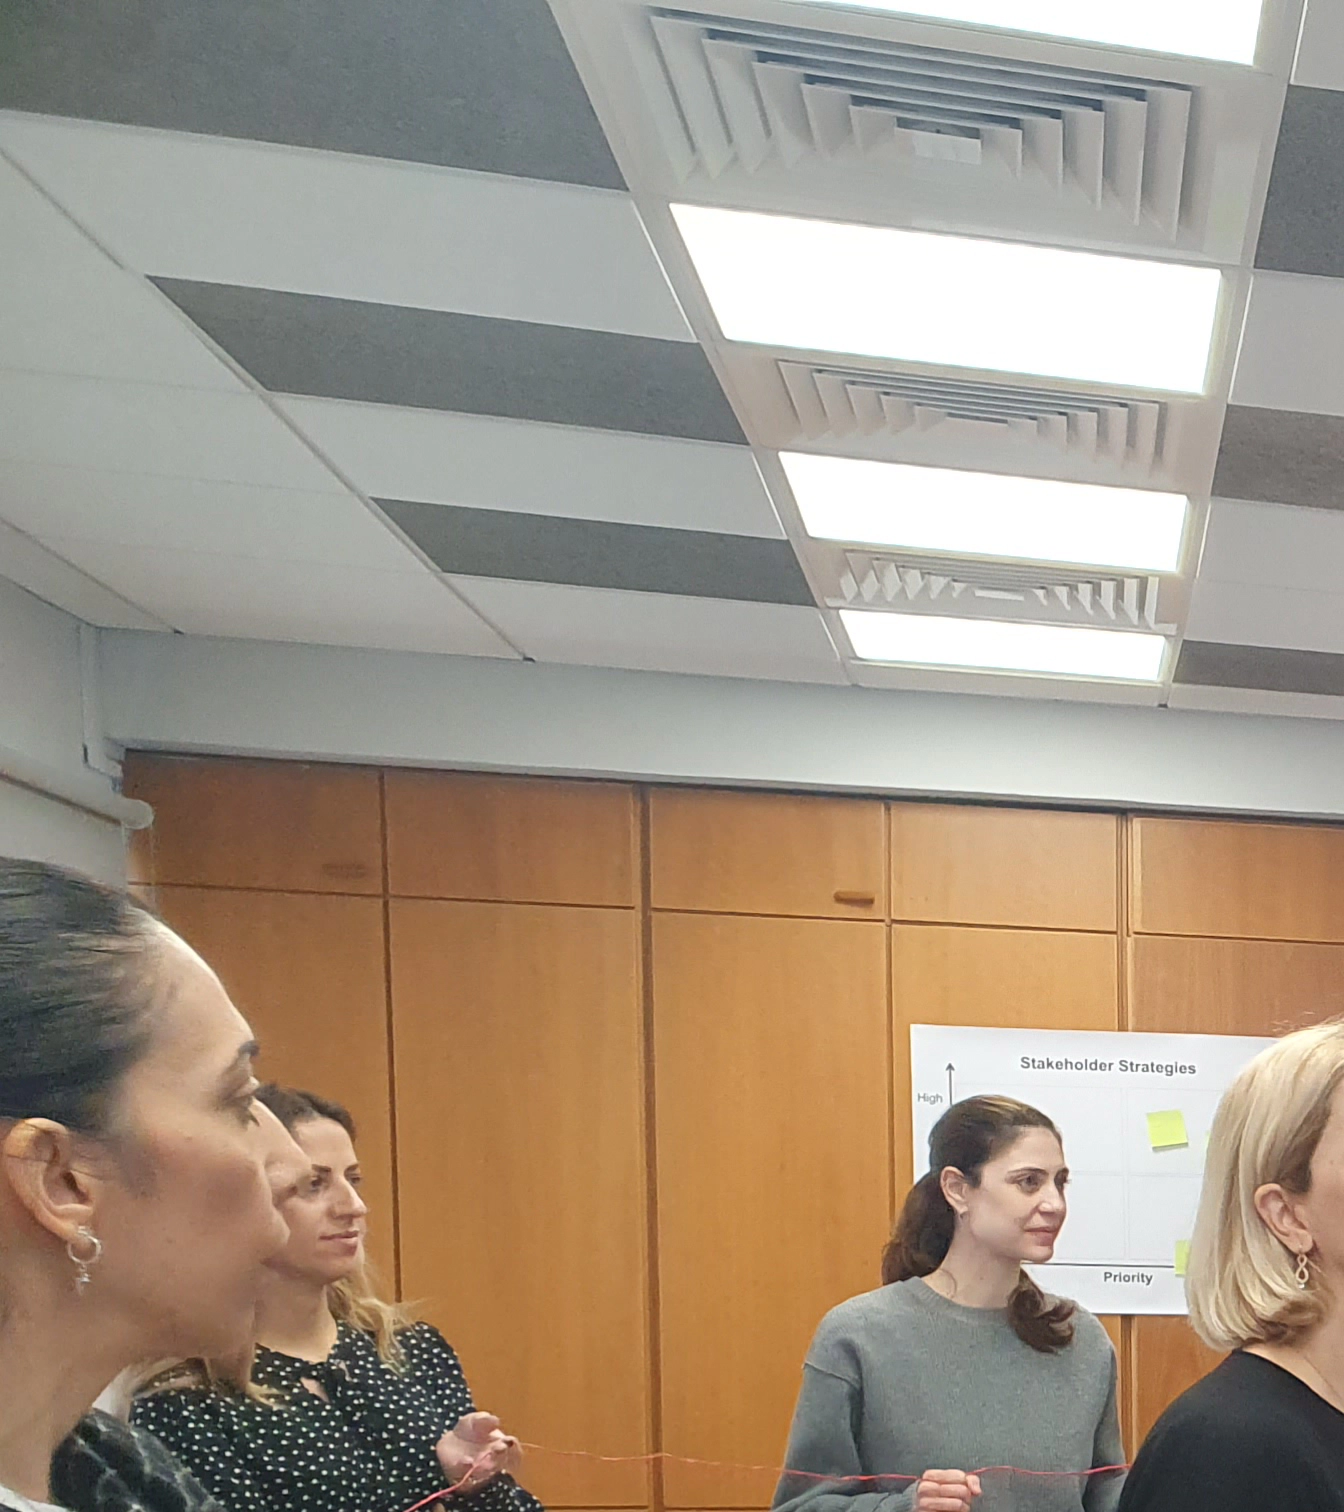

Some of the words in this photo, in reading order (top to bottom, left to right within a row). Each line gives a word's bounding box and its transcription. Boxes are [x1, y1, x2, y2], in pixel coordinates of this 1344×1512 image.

[1020, 1056, 1114, 1072] Stakeholder
[1118, 1059, 1197, 1077] Strategies
[917, 1092, 943, 1105] High
[1103, 1271, 1153, 1286] Priority
